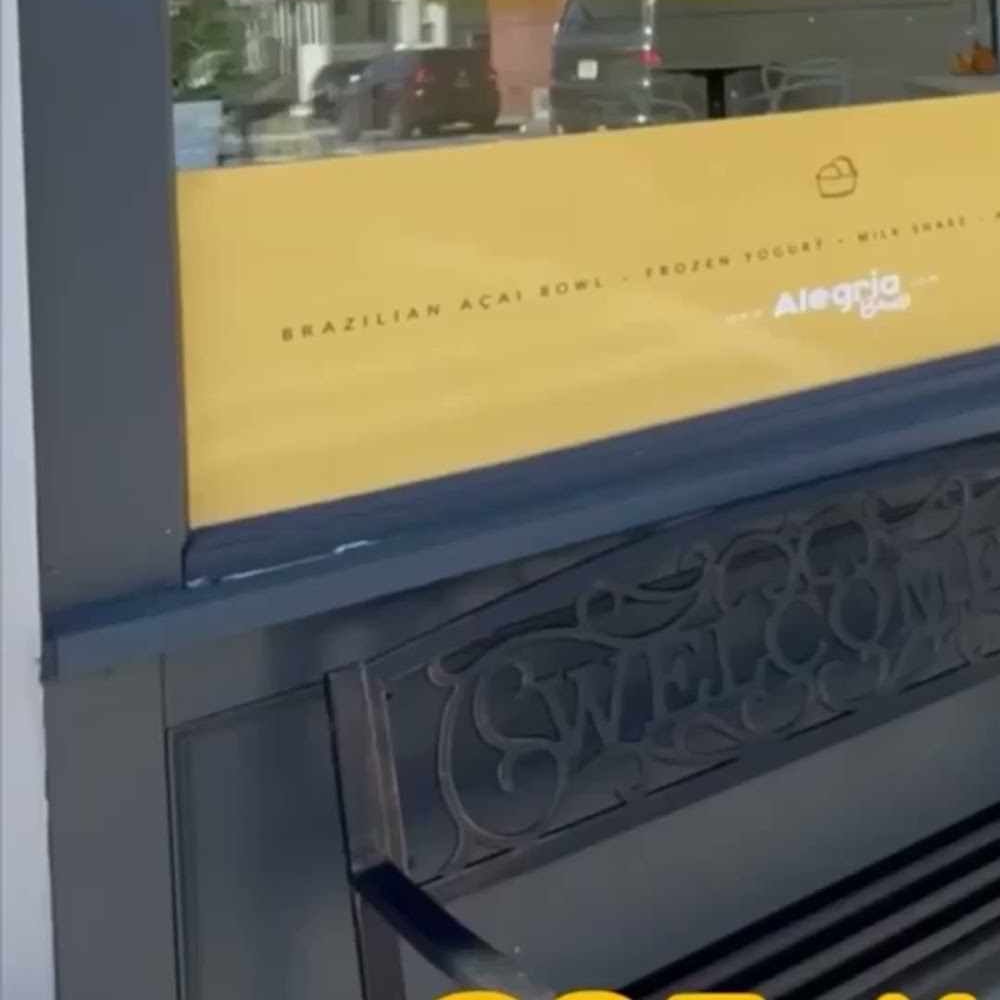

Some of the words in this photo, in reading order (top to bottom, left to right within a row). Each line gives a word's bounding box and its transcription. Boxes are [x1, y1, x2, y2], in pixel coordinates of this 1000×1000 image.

[281, 303, 440, 342] BRAZILIAN
[540, 277, 603, 298] BOWL
[645, 255, 730, 279] FROZEN
[745, 238, 824, 264] YOGURT
[773, 268, 901, 318] Alegria
